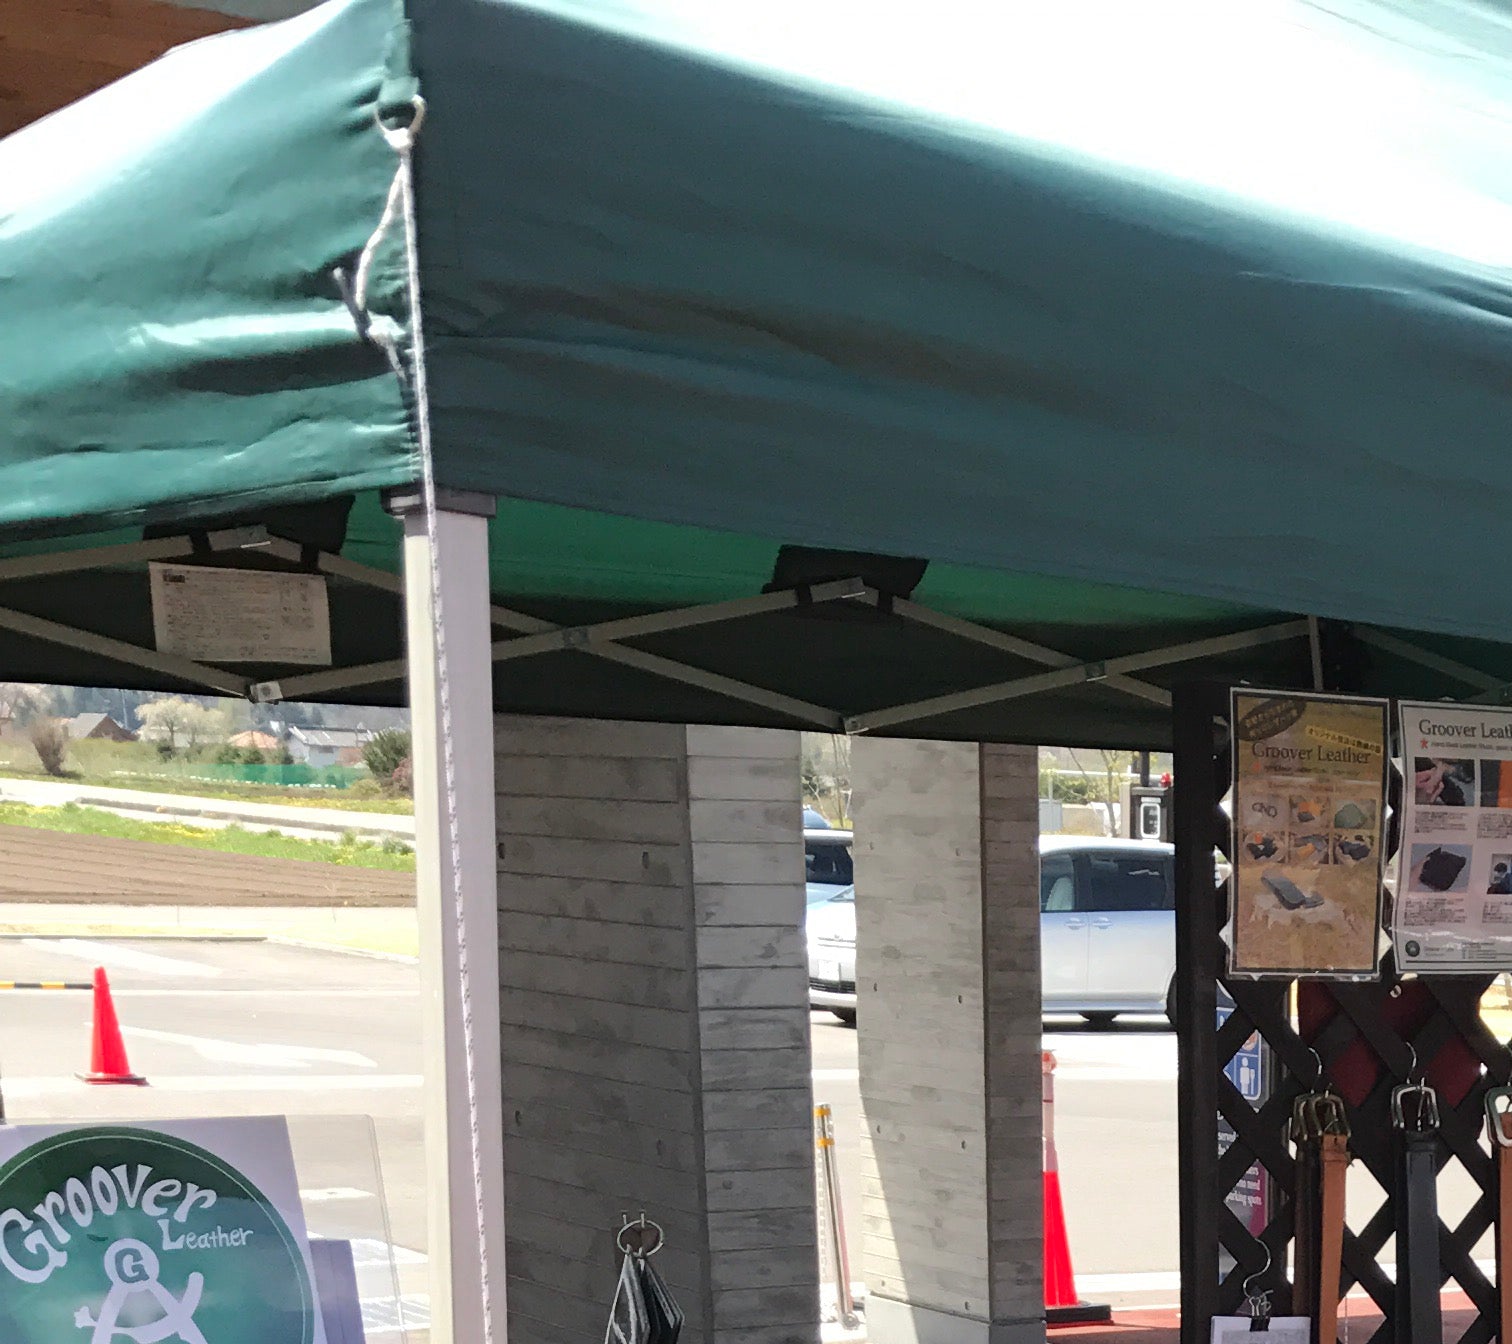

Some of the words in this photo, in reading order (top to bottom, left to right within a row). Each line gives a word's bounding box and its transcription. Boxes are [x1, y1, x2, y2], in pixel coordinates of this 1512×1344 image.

[1418, 719, 1477, 737] Groover
[1252, 742, 1312, 761] Groover
[1317, 745, 1371, 764] Leather
[0, 1164, 217, 1283] Groover
[157, 1218, 254, 1251] Leather
[115, 1248, 150, 1283] G
